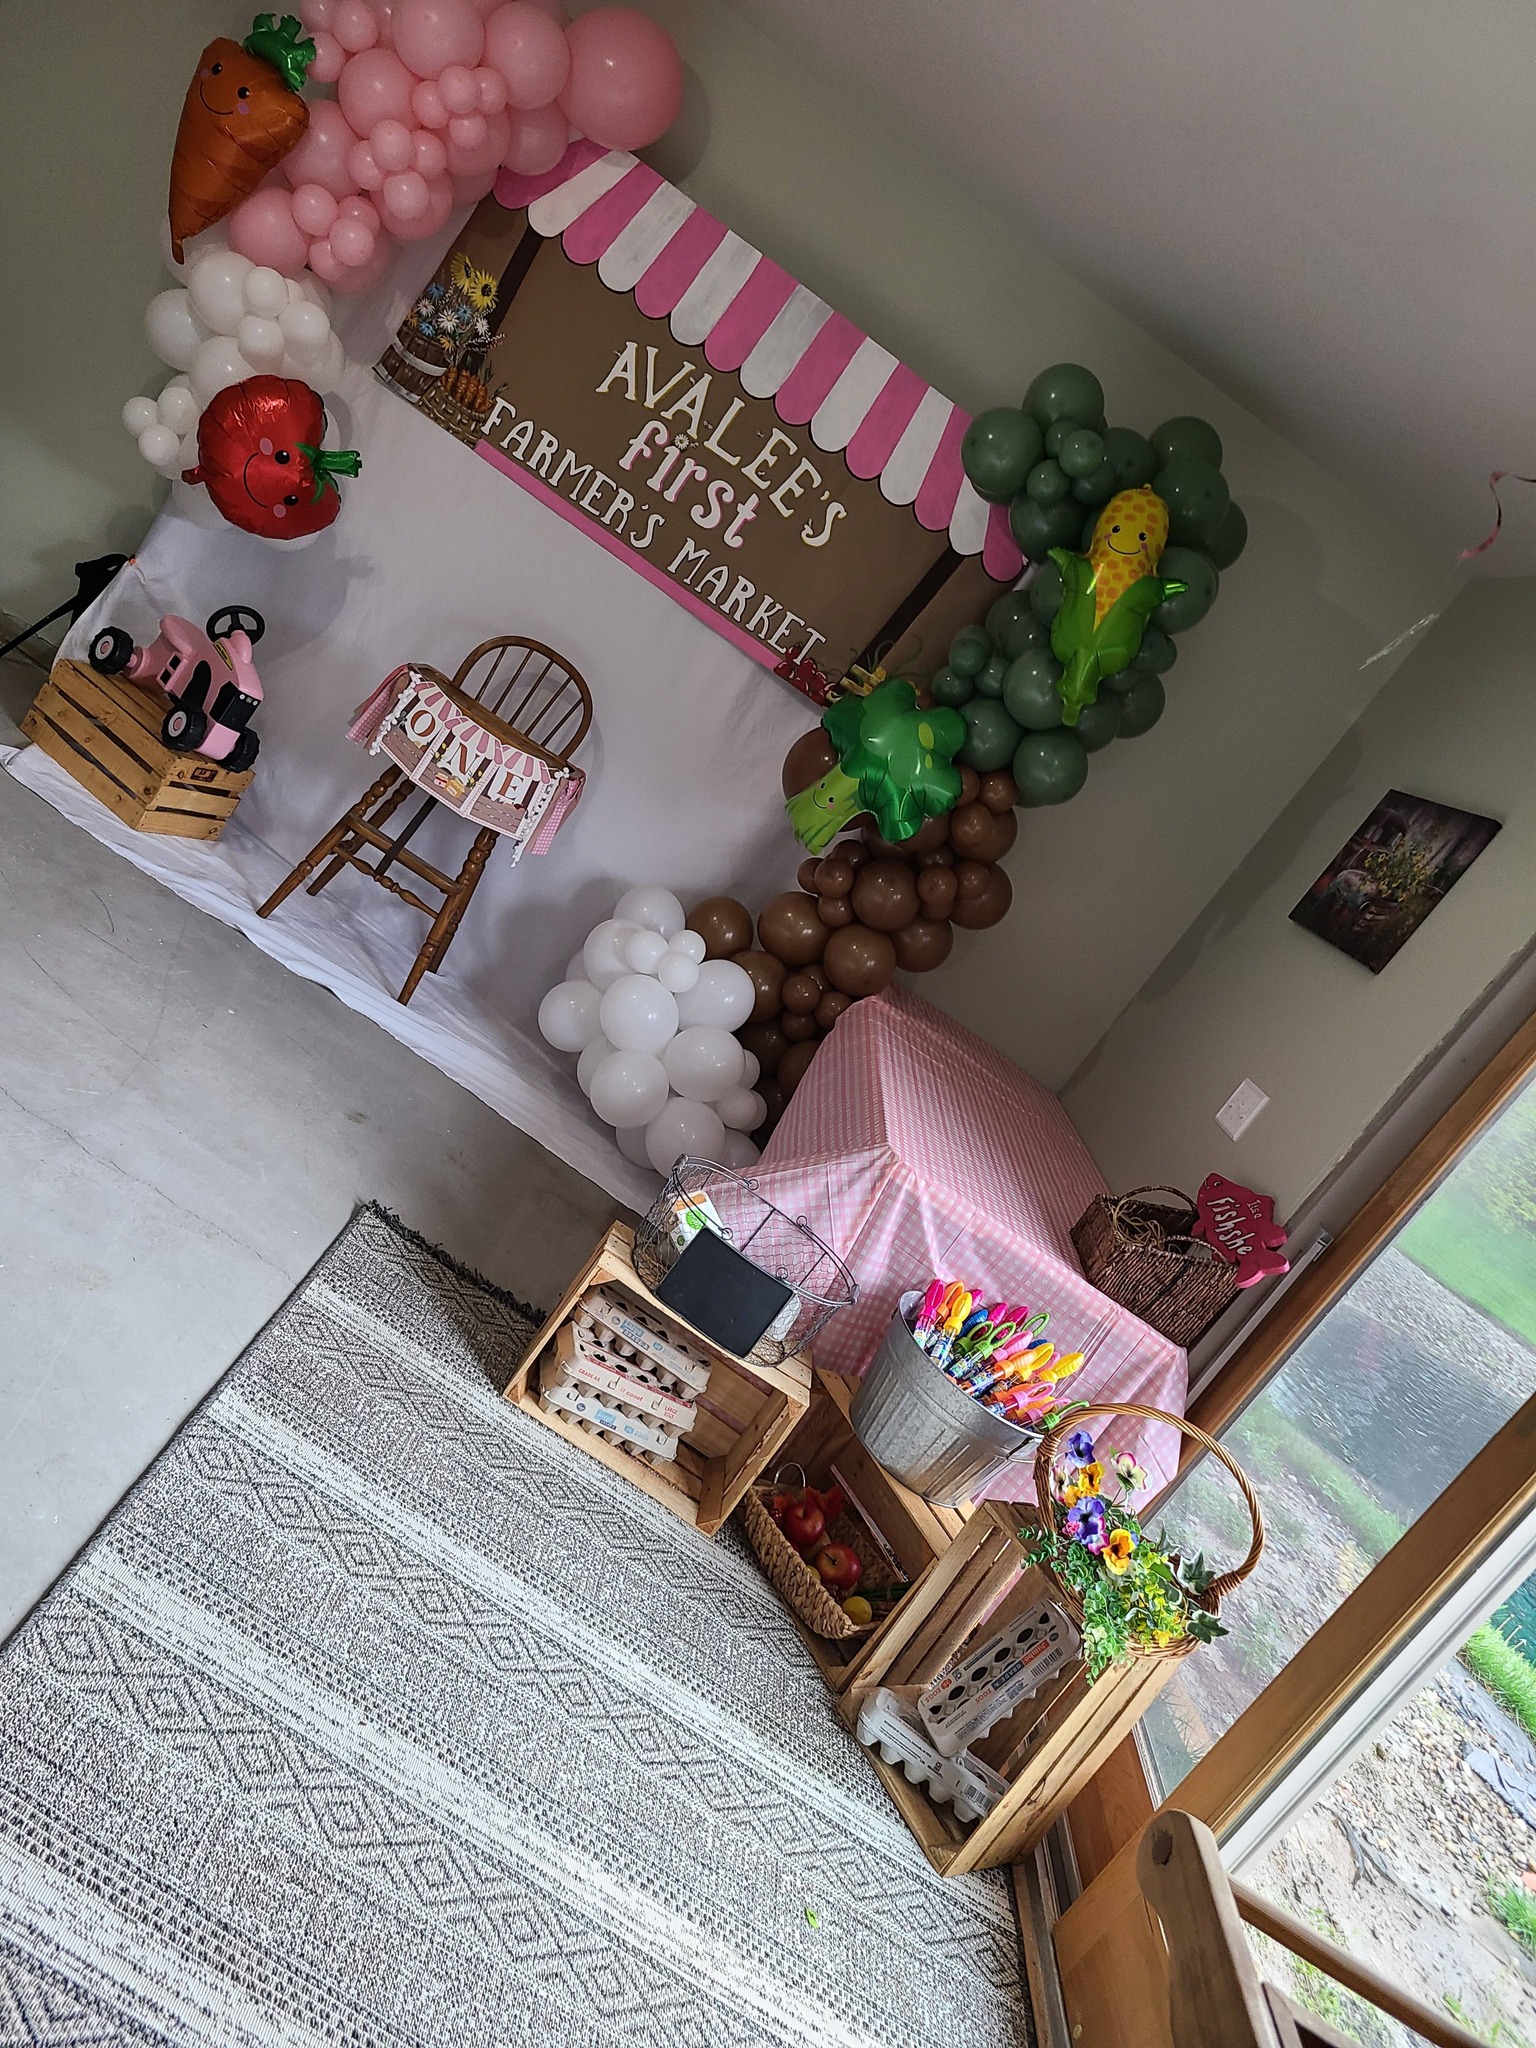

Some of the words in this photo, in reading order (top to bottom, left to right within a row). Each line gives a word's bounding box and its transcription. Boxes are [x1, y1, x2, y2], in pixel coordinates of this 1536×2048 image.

[595, 341, 846, 546] AVALEE'S
[618, 420, 761, 549] first
[480, 397, 666, 549] FARMER'S
[667, 537, 826, 665] MARKET
[1023, 1641, 1047, 1663] Jumbo
[1000, 1662, 1023, 1683] GRADE
[924, 1687, 942, 1703] EGGS
[974, 1688, 993, 1704] EGGS
